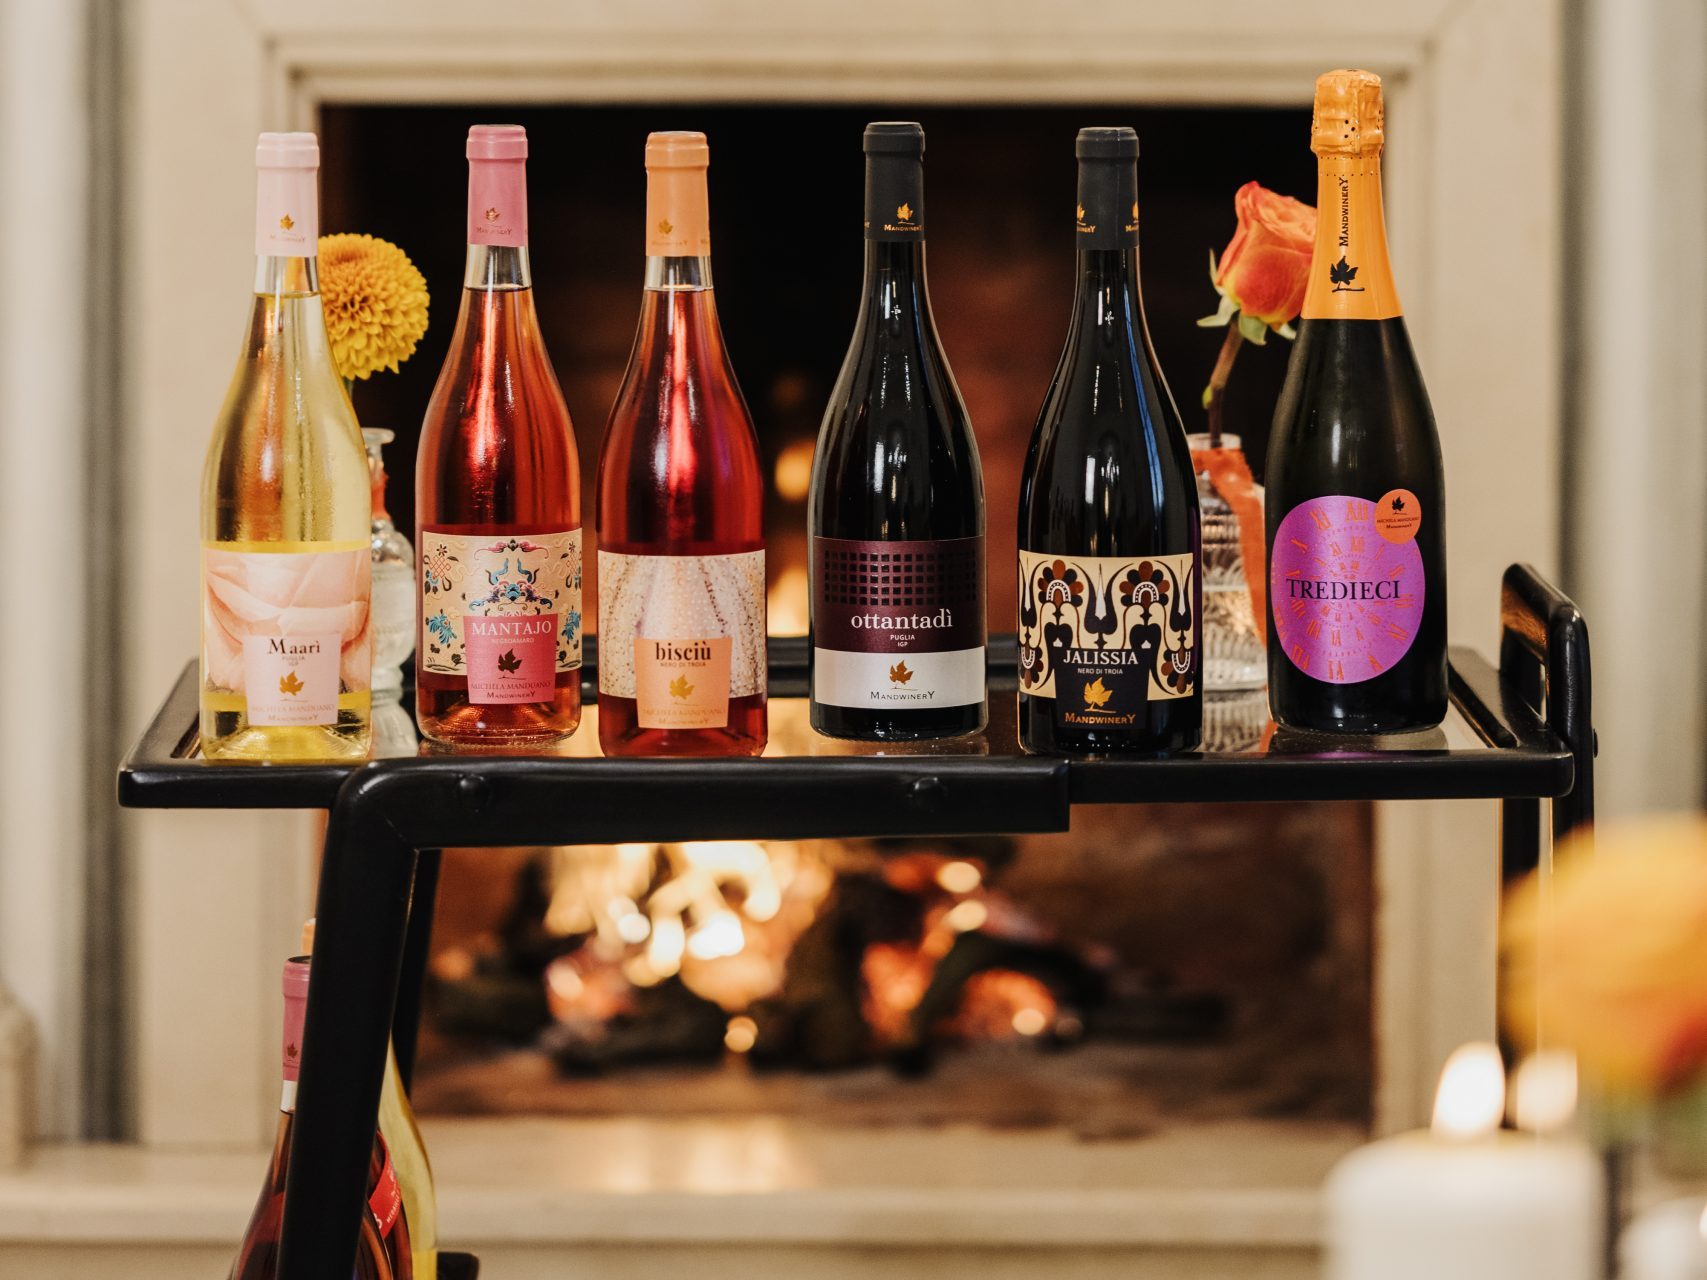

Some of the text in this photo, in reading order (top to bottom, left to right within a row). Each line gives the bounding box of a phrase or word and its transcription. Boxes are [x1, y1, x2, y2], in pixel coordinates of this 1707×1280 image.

[1338, 177, 1349, 247] MANDWINERY
[1286, 577, 1401, 600] TREDIECI
[850, 607, 953, 630] ottantadì
[471, 620, 552, 636] MANTAJO
[655, 640, 712, 661] bisciù
[1062, 649, 1139, 666] JALISSIA
[486, 690, 536, 699] MANDWINERY
[870, 690, 935, 701] MANDWINERY
[1064, 711, 1137, 725] MANDWINERY
